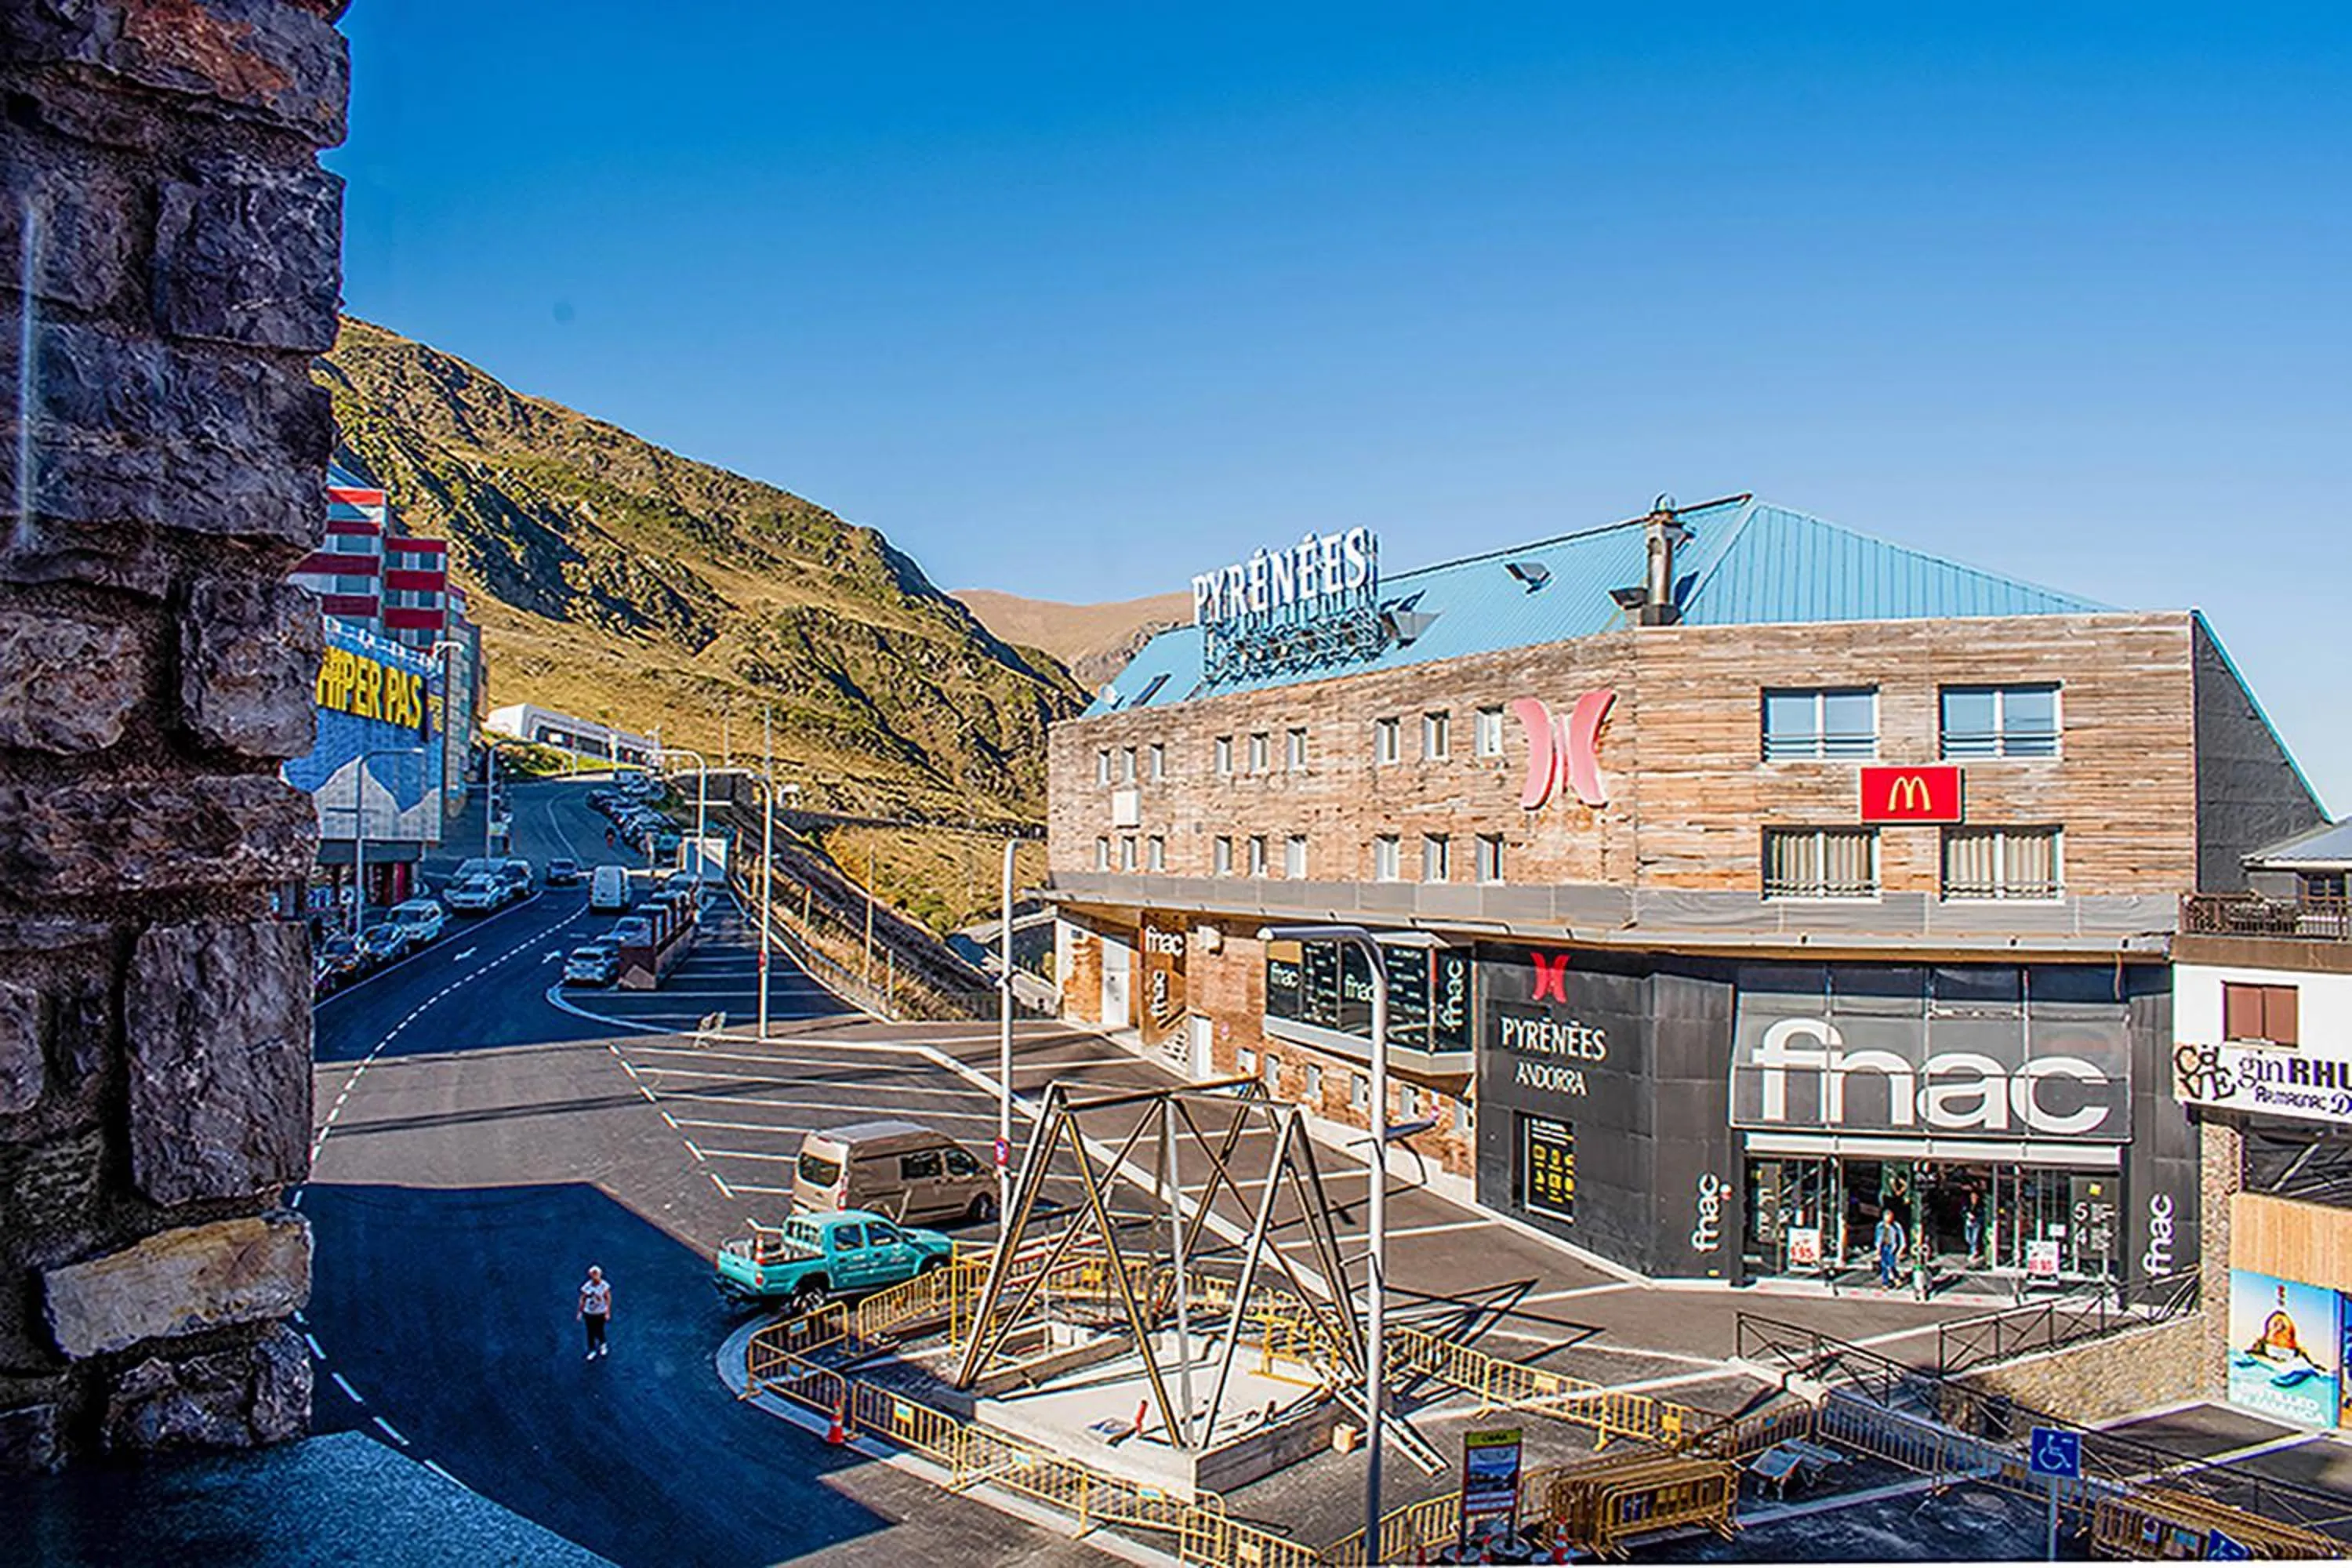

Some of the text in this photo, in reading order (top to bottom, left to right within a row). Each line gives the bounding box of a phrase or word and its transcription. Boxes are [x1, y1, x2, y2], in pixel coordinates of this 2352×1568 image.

[383, 666, 423, 729] PAS
[1145, 924, 1184, 957] fnac
[1270, 961, 1299, 988] fnac
[1439, 960, 1465, 1033] fnac
[1515, 1061, 1588, 1096] ANDORRA
[1751, 1018, 2110, 1134] fnac
[2238, 1049, 2284, 1089] gin
[1691, 1173, 1719, 1253] fnac
[2142, 1193, 2173, 1276] fnac
